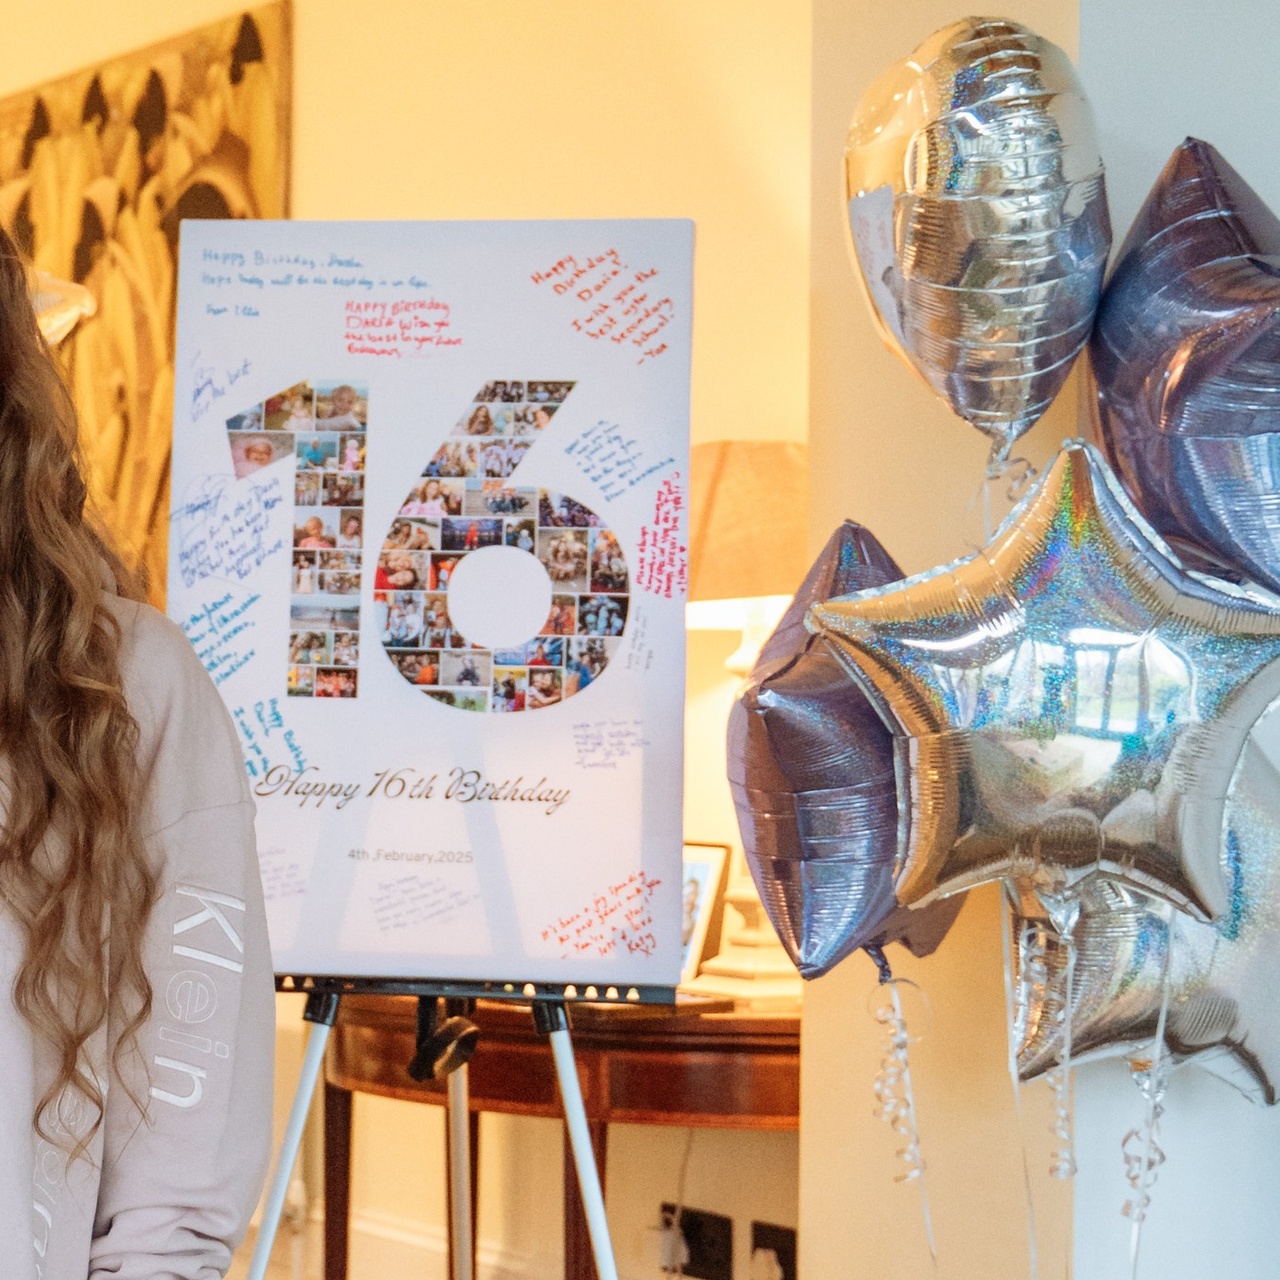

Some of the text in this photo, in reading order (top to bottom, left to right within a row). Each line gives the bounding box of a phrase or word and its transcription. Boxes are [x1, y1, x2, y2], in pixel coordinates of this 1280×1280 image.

[202, 249, 246, 267] Happy
[531, 255, 578, 285] Happy
[225, 378, 631, 714] 16
[254, 765, 362, 810] Happy
[444, 766, 573, 816] Birthday
[347, 848, 370, 861] 4th
[150, 880, 247, 1110] Klein
